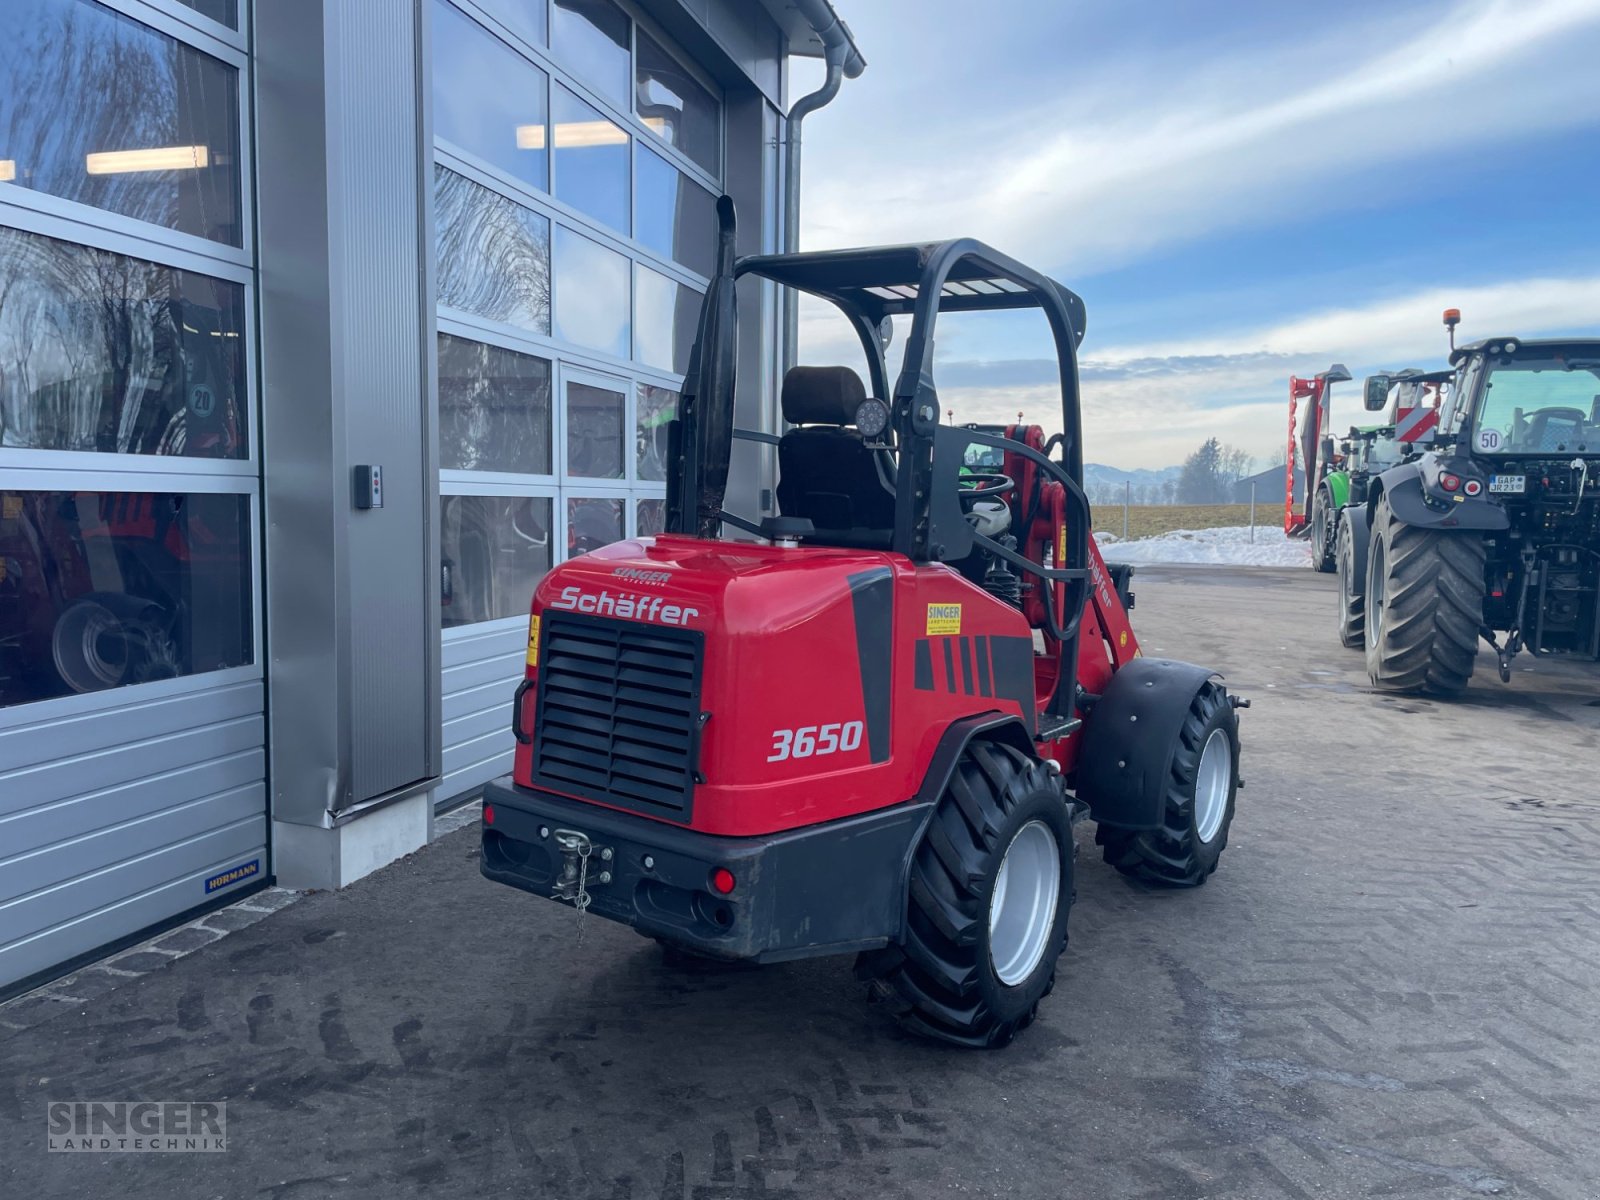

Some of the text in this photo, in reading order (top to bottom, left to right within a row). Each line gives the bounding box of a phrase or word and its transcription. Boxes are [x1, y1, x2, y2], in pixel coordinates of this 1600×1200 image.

[194, 389, 210, 411] 20
[1481, 432, 1498, 448] 50
[1490, 484, 1515, 492] JR 23
[1497, 476, 1516, 484] GAP
[612, 567, 673, 583] SINGER
[551, 586, 699, 625] Schäffer
[928, 606, 960, 619] SINGER
[766, 720, 864, 763] 3650
